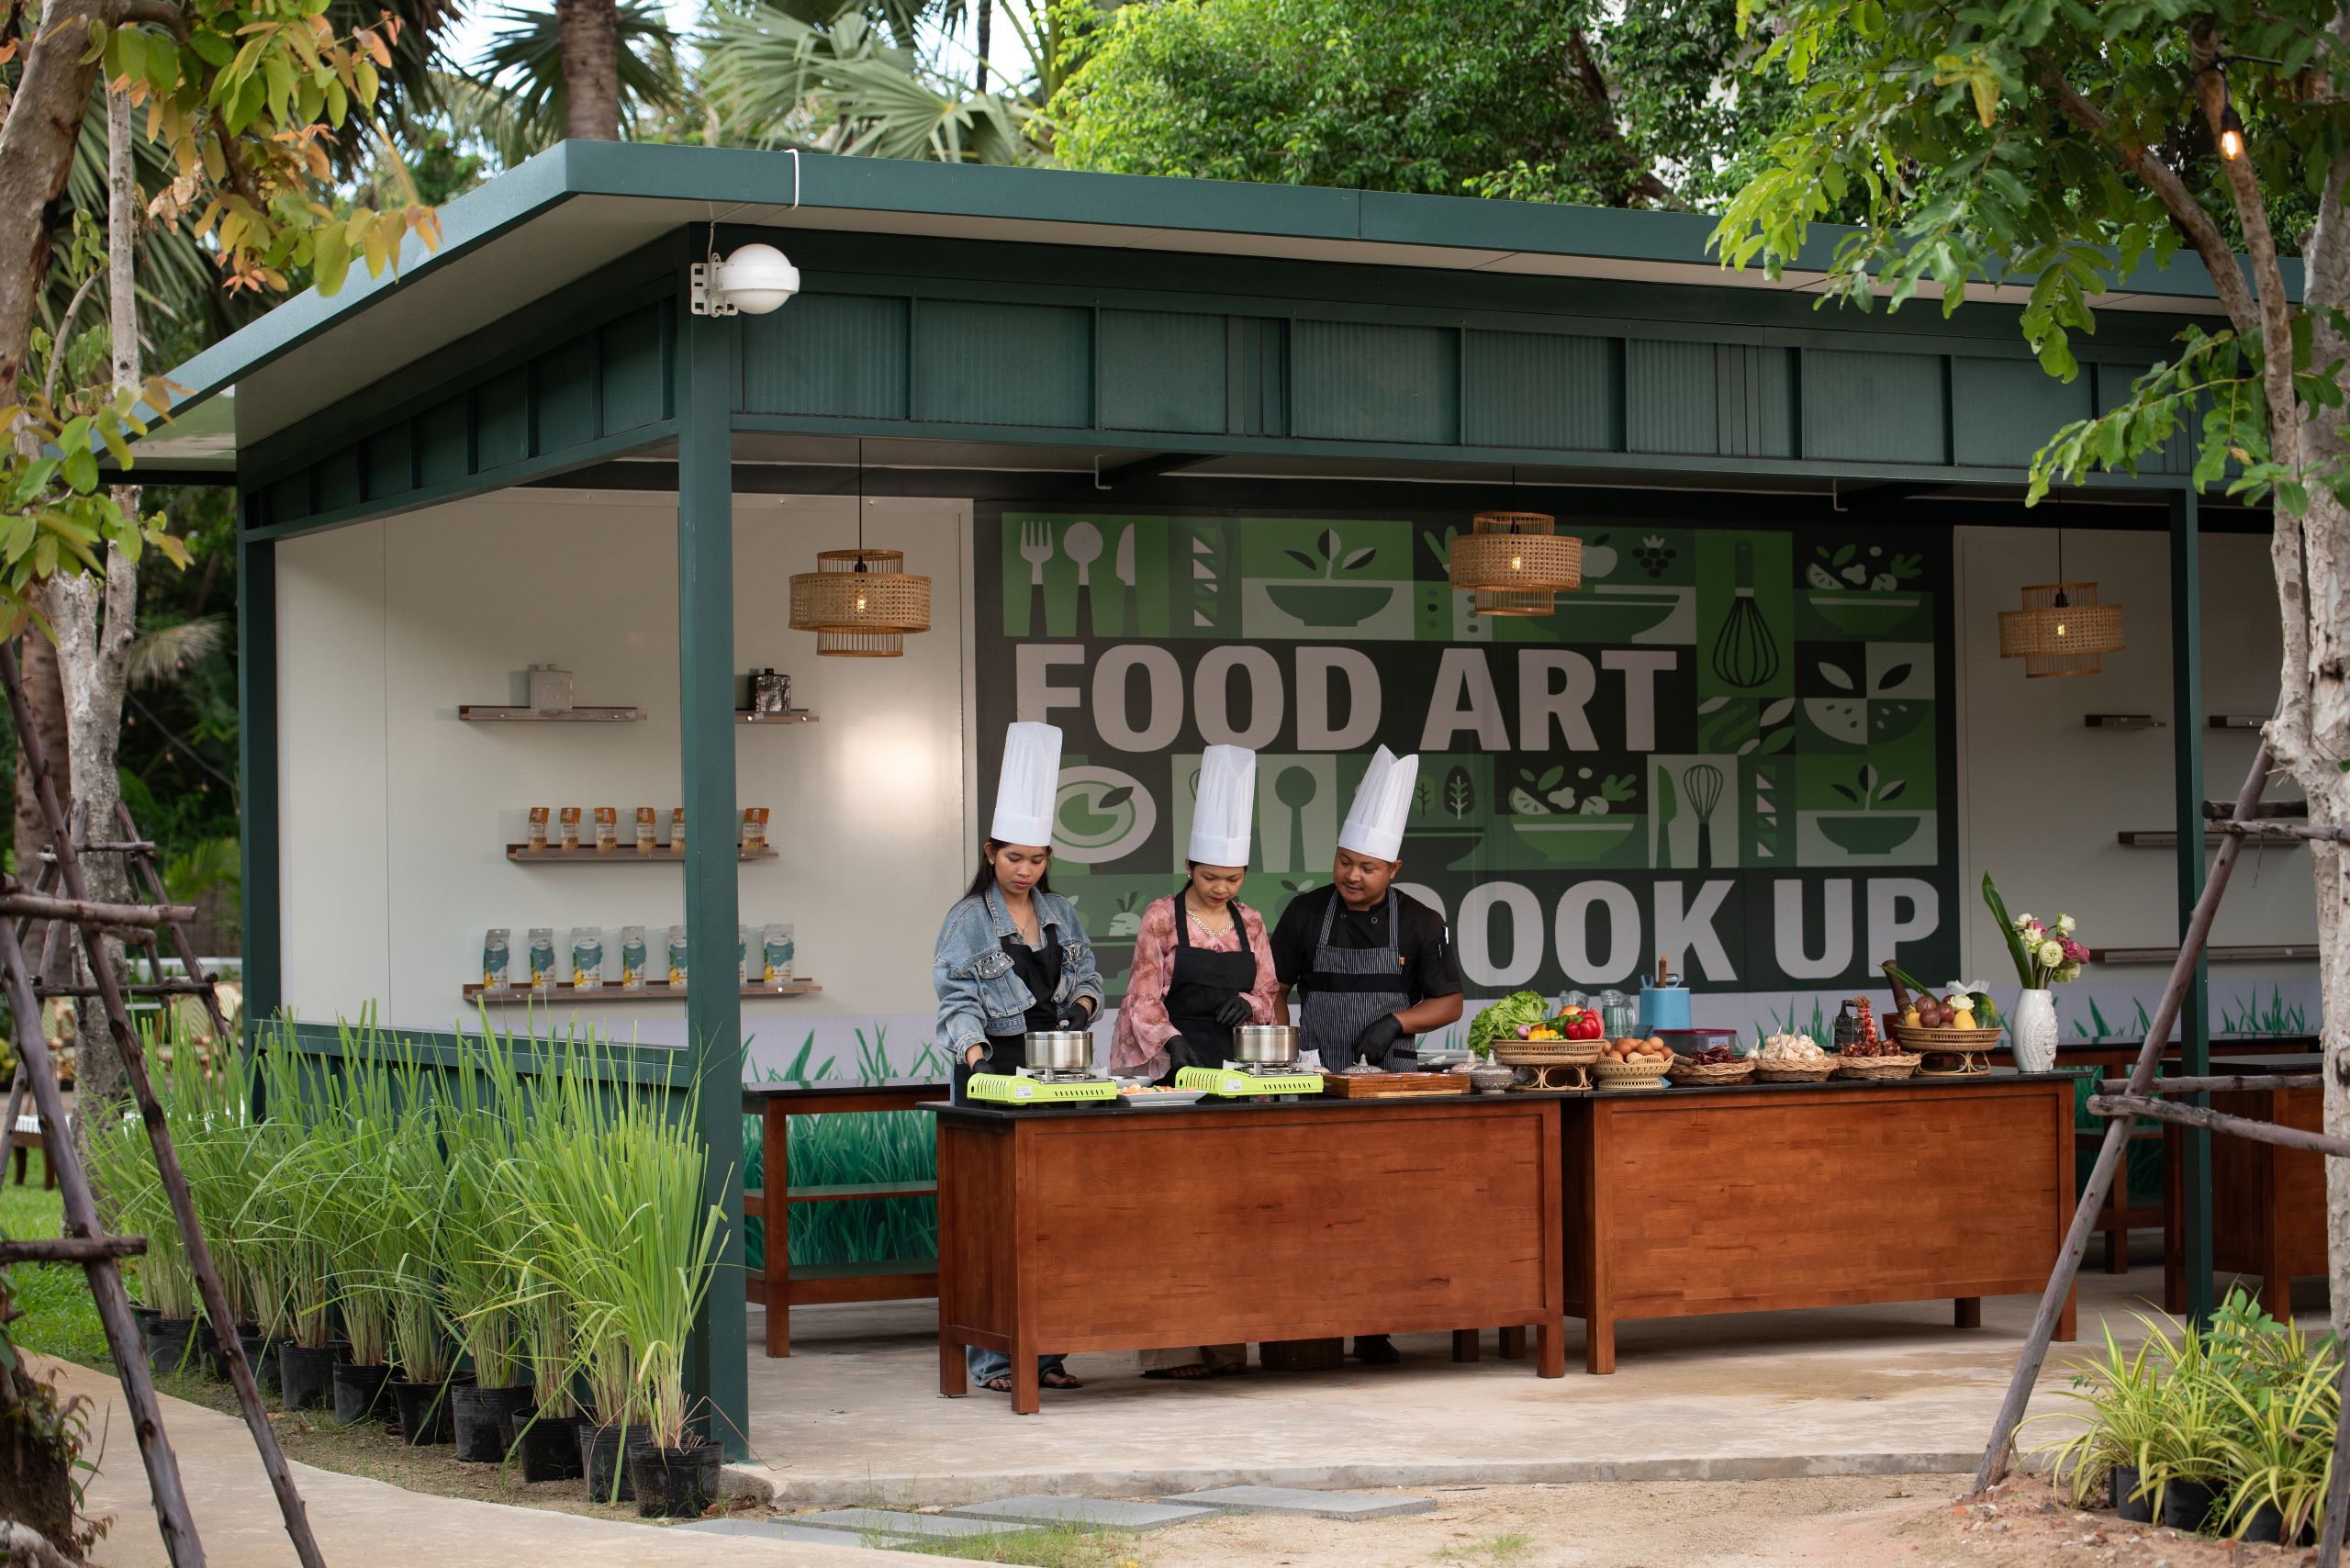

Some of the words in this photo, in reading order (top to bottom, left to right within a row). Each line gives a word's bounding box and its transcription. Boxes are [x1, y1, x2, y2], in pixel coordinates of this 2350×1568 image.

[1016, 644, 1382, 753] FOOD
[1419, 647, 1678, 752] ART
[1390, 879, 1739, 987] OOK
[1774, 878, 1940, 980] UP
